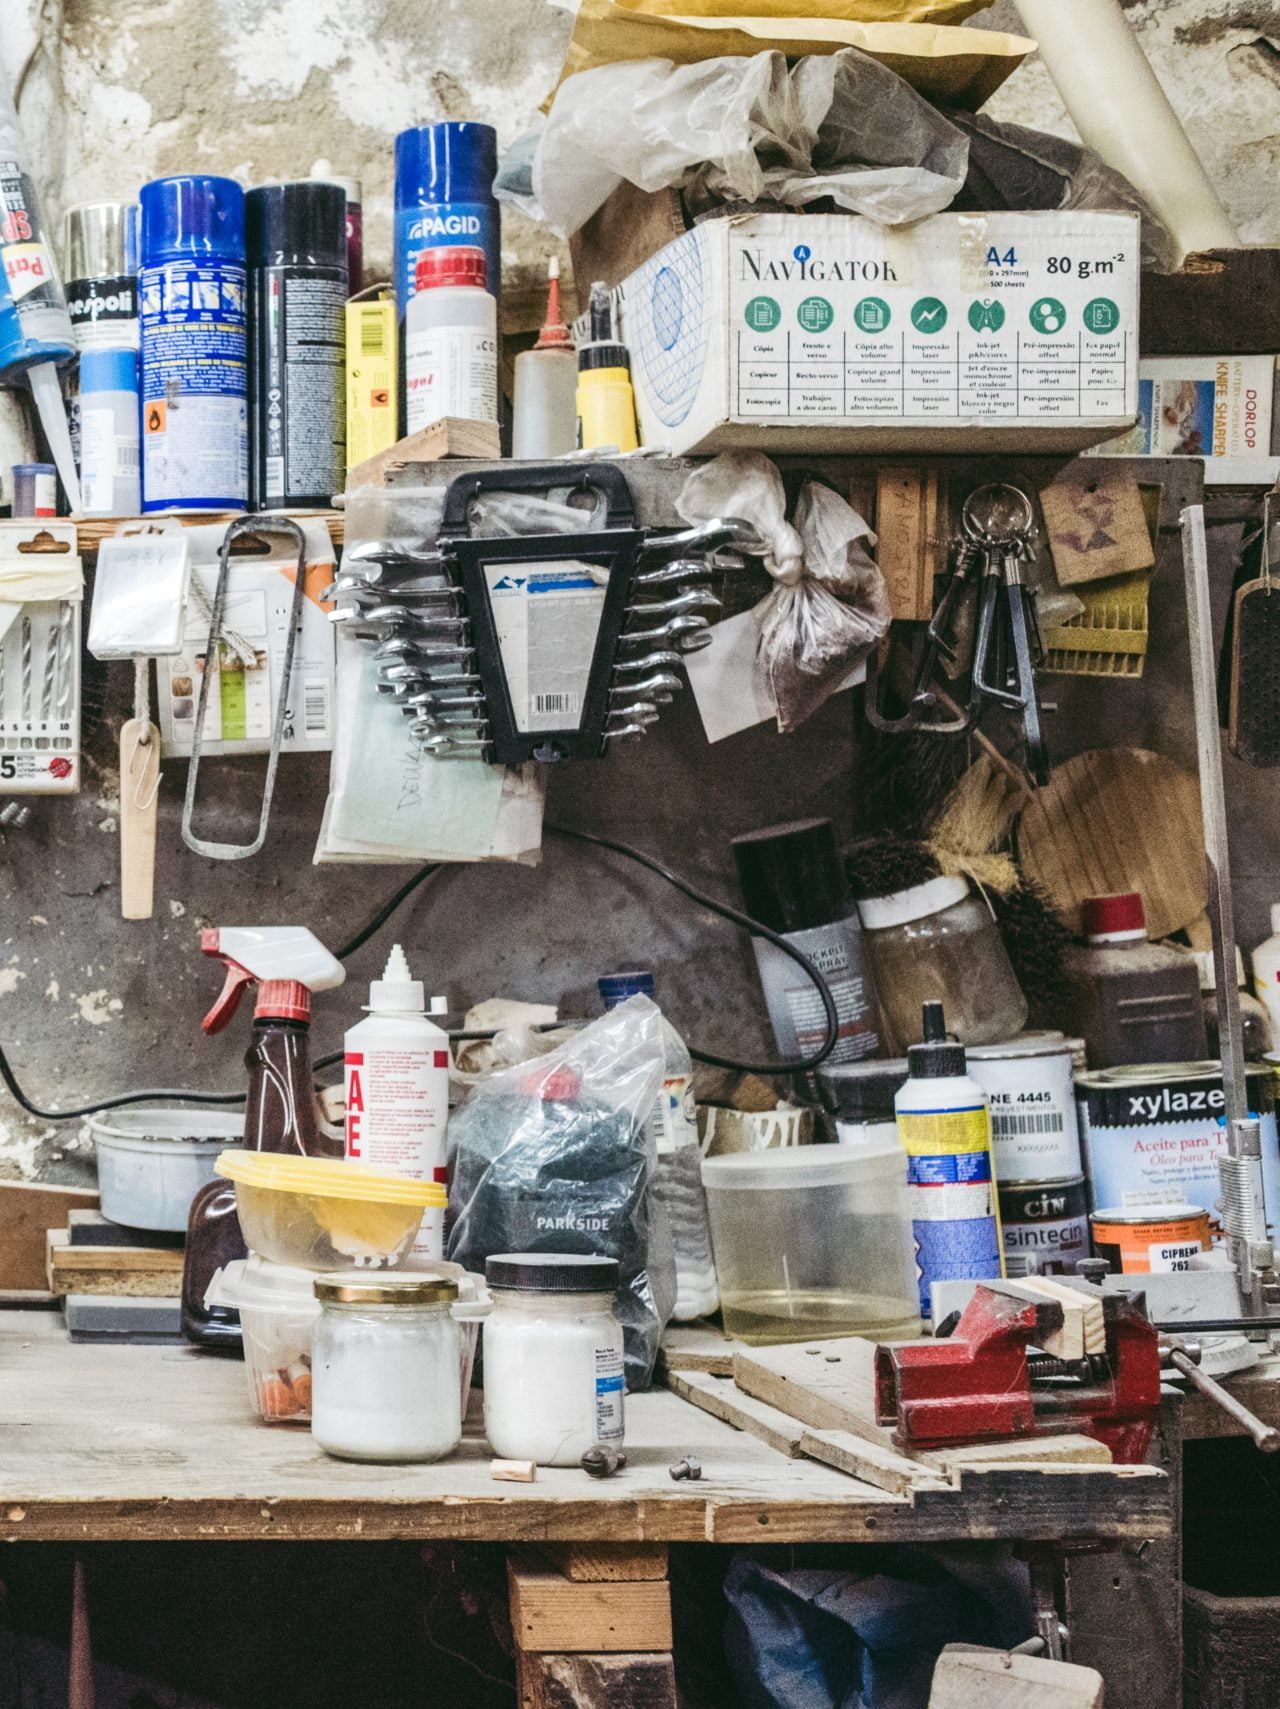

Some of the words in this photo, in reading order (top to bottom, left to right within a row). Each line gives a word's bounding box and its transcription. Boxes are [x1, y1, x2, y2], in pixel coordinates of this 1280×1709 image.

[423, 216, 481, 237] PAGID
[986, 246, 1018, 267] A4
[1046, 256, 1072, 274] 80
[69, 290, 132, 315] nespoli
[1216, 361, 1229, 397] KNIFE
[1245, 389, 1257, 448] DORLOP
[891, 490, 914, 608] AMOSTRA
[60, 723, 70, 731] 10
[818, 957, 846, 970] PRAY
[1017, 1091, 1052, 1104] 4445
[1128, 1088, 1226, 1119] xylaze
[1134, 1138, 1177, 1154] Aceite
[1181, 1137, 1209, 1152] para
[1179, 1153, 1204, 1166] para
[536, 1216, 610, 1231] PARKSIDE
[1005, 1223, 1083, 1247] sintecin
[1171, 1261, 1189, 1272] 262
